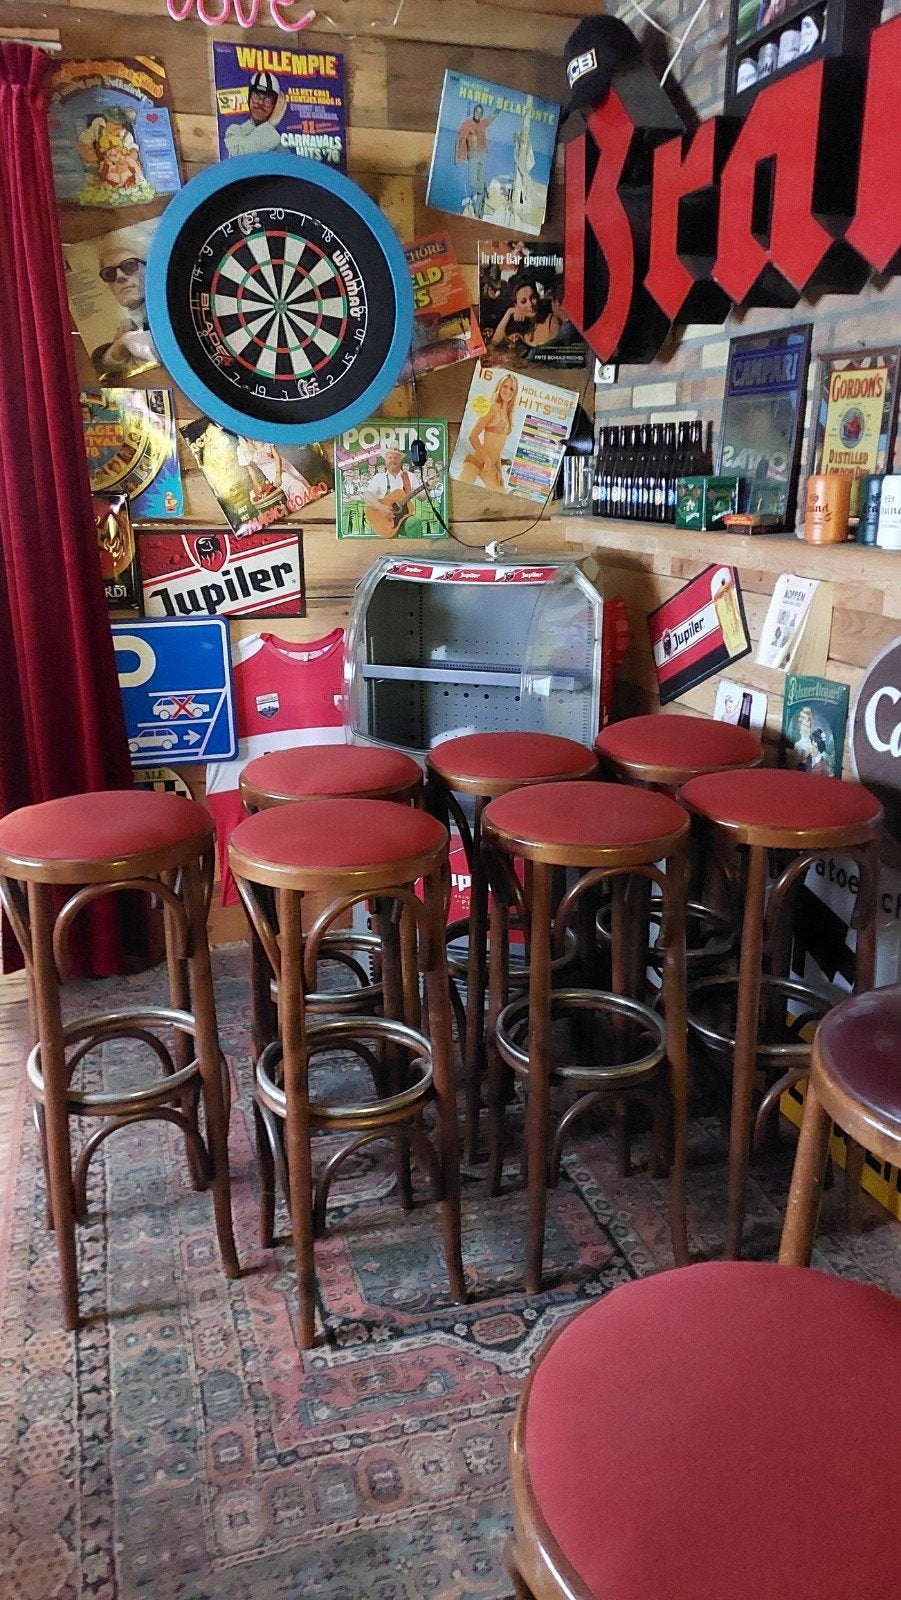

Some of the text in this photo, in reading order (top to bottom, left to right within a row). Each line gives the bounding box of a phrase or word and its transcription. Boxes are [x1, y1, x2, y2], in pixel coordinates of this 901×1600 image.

[236, 46, 338, 77] WILLEMPIE
[567, 53, 593, 80] CB
[458, 87, 493, 107] HARRY
[280, 133, 342, 149] CARNAVALS
[296, 147, 321, 160] HITS
[269, 208, 285, 220] 20
[220, 222, 234, 237] 12
[321, 227, 334, 243] 18
[491, 252, 503, 265] der
[524, 252, 563, 268] gegenübe
[521, 385, 575, 408] HOLLANDSE
[519, 396, 551, 416] HITS
[460, 571, 480, 580] Jupiler
[521, 570, 543, 579] Jupiler
[104, 584, 128, 598] RDI
[149, 561, 294, 616] Jupiler
[672, 617, 706, 651] Jupiler
